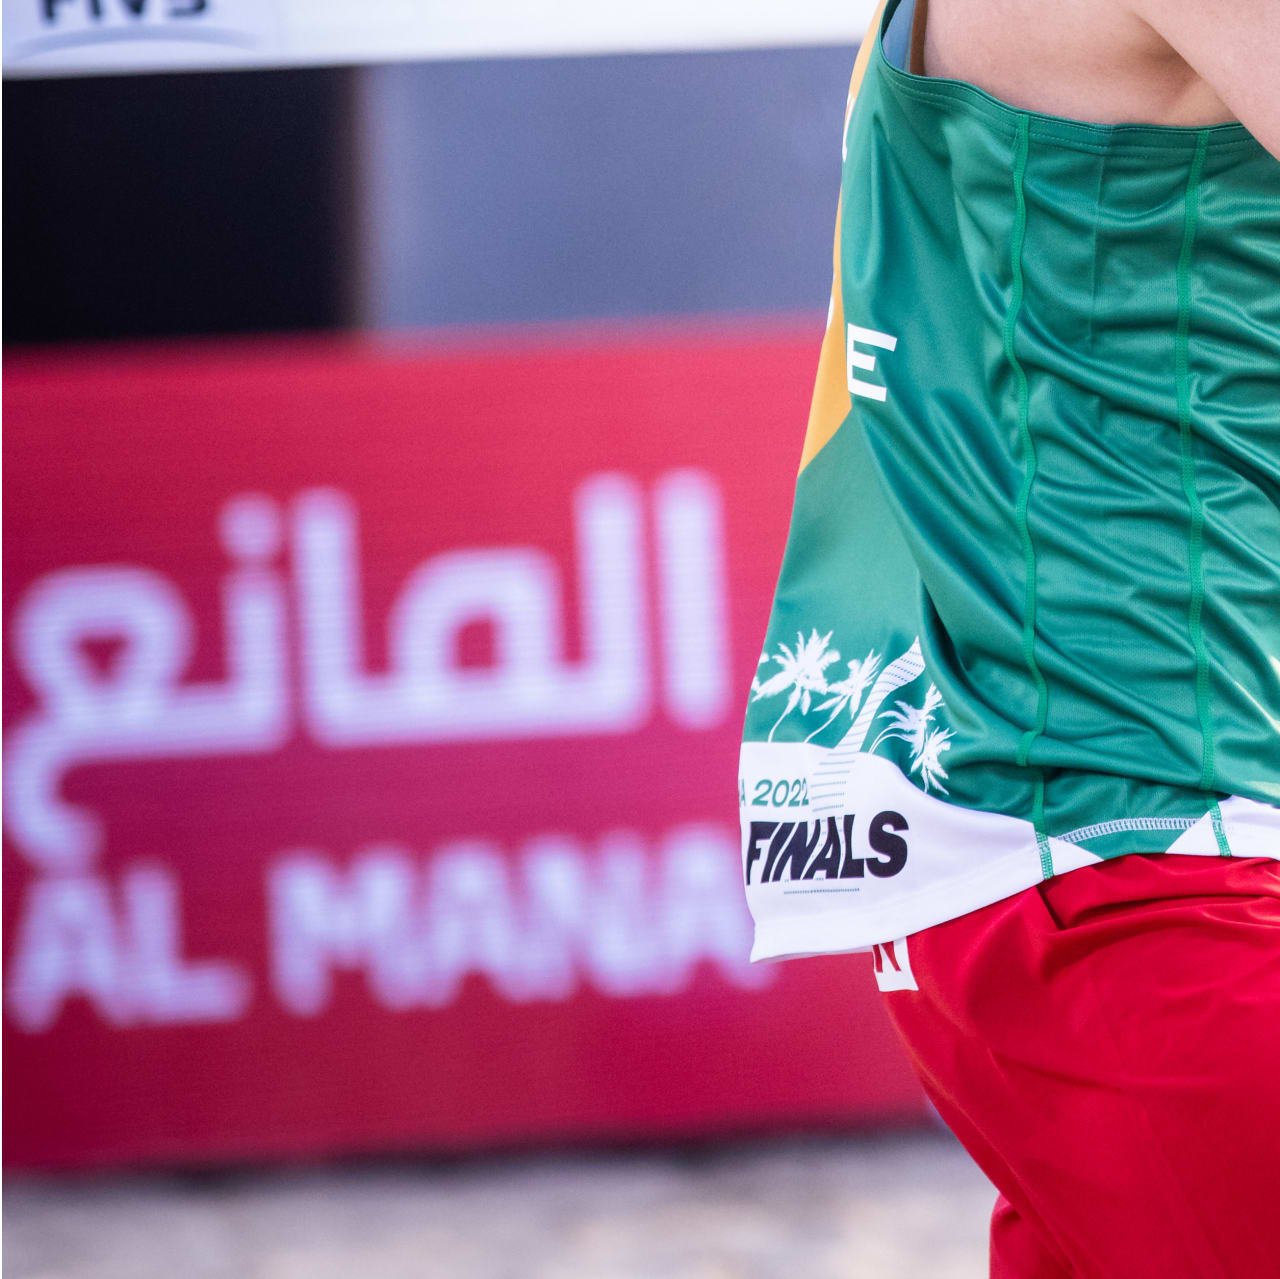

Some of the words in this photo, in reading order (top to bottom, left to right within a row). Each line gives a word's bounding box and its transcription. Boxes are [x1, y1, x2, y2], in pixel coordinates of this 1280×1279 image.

[4, 469, 731, 870] المانع
[746, 810, 909, 886] FINALS
[6, 860, 250, 1032] AL
